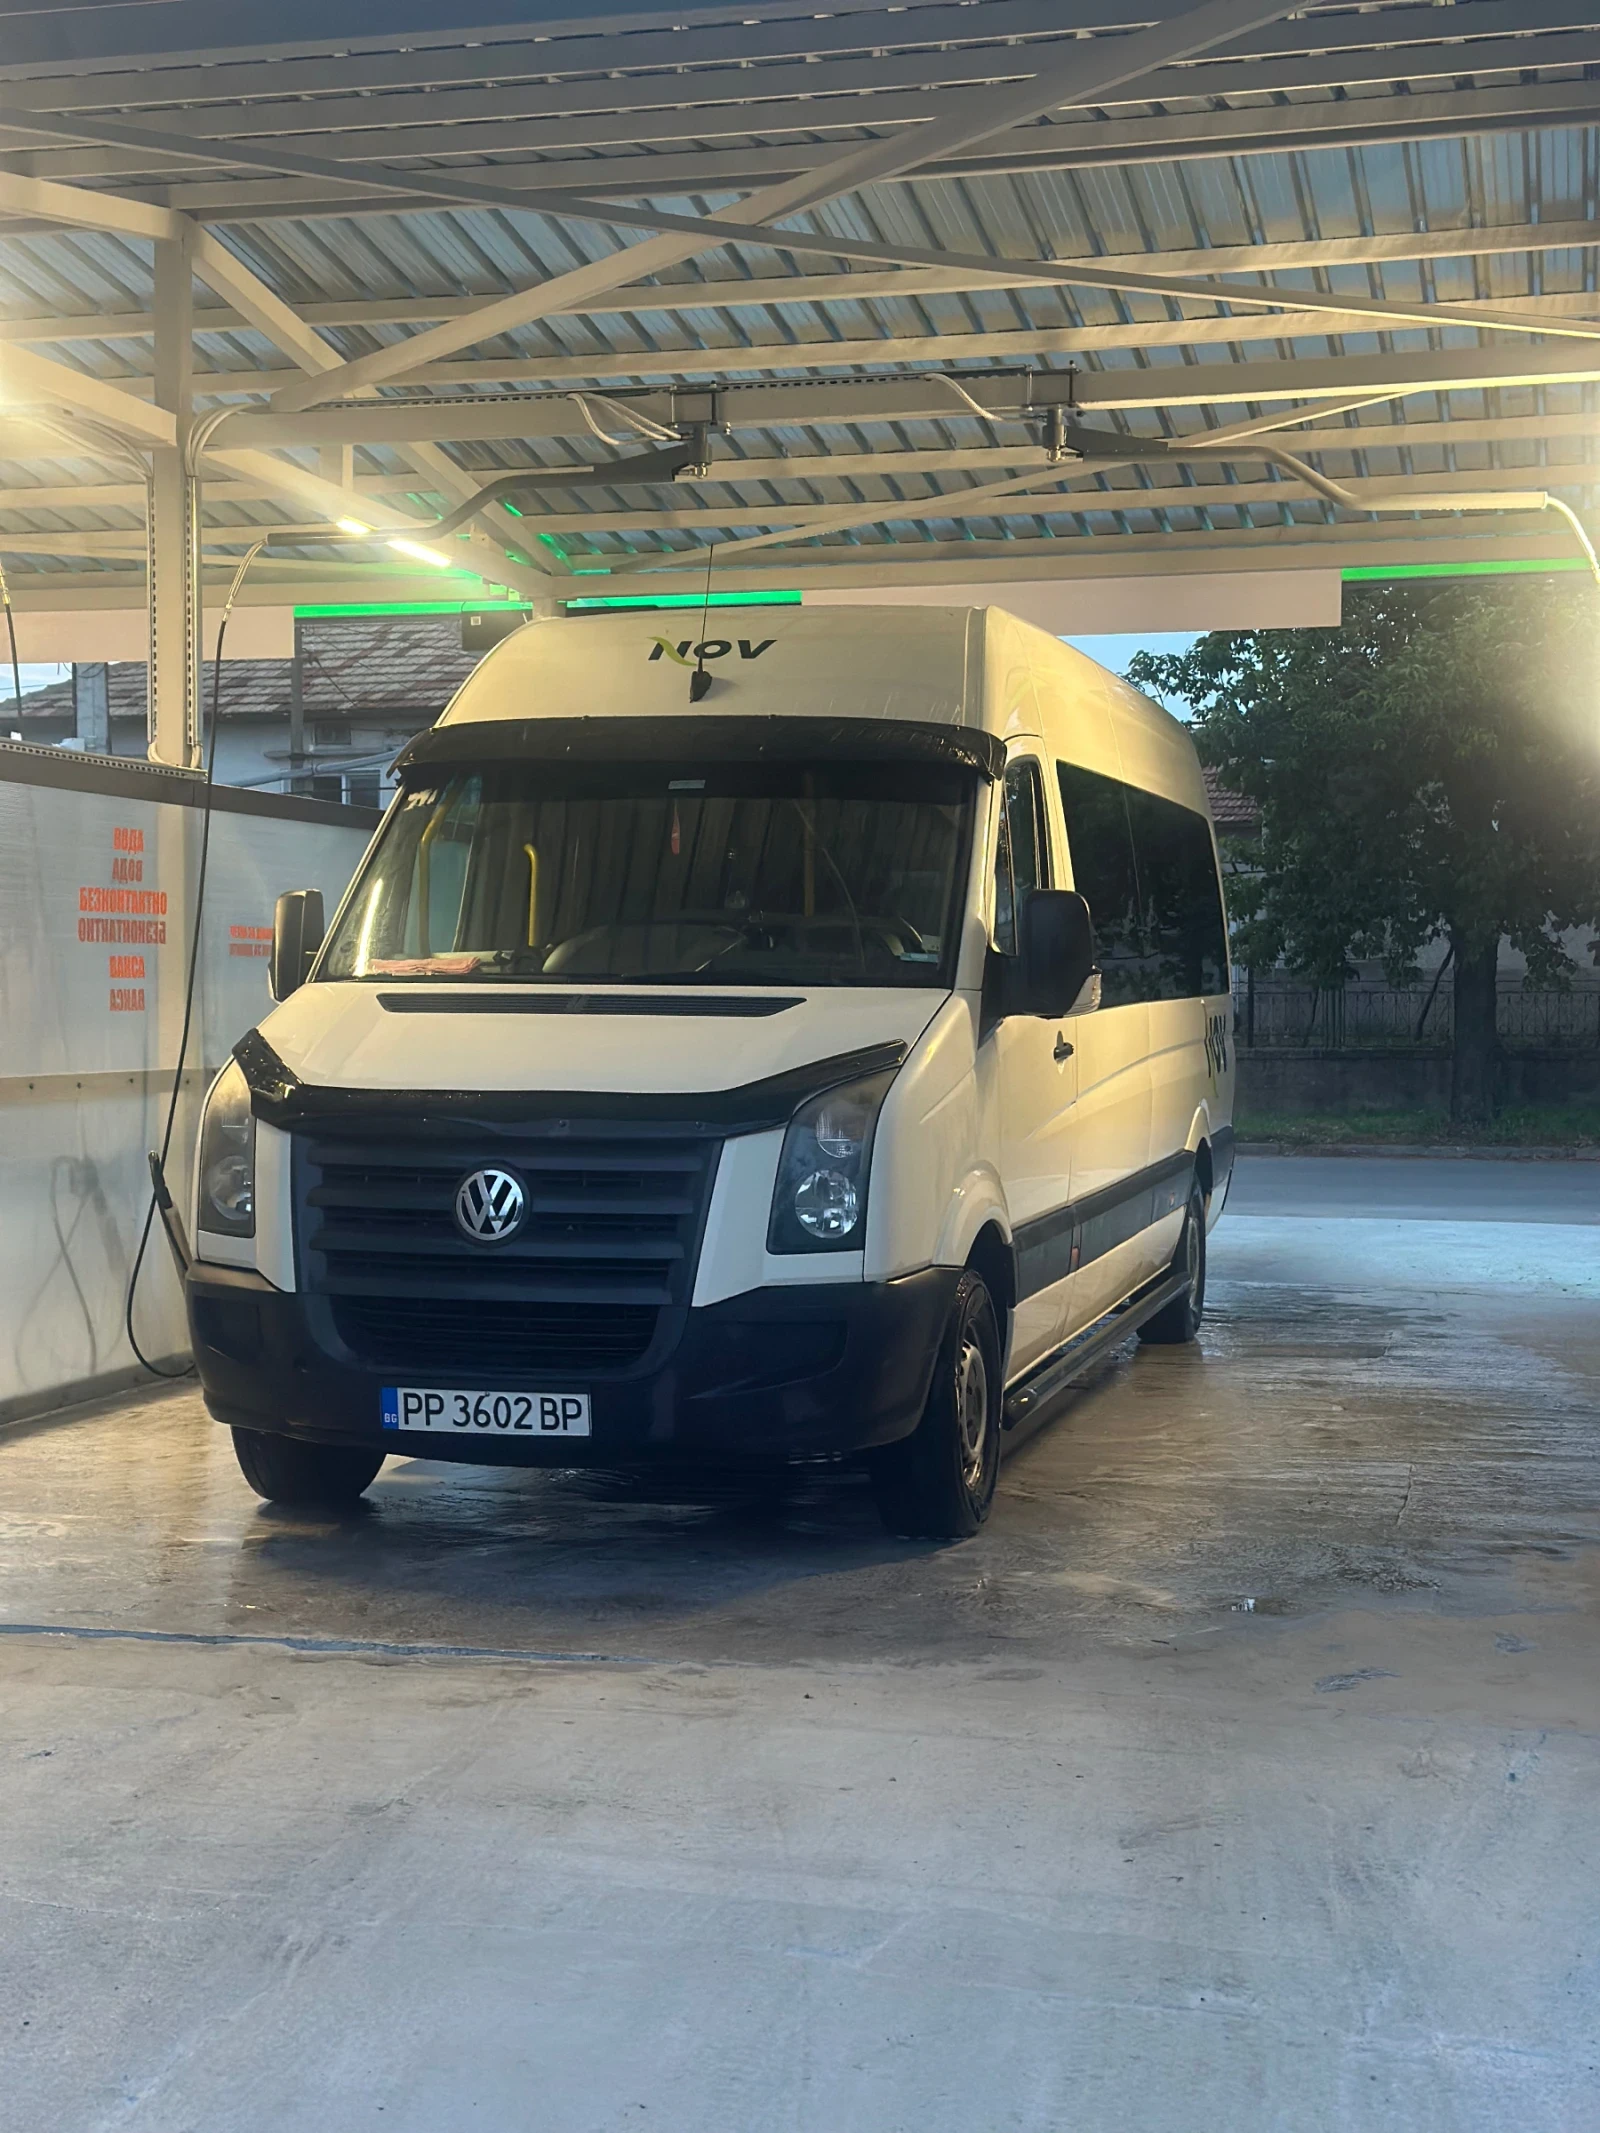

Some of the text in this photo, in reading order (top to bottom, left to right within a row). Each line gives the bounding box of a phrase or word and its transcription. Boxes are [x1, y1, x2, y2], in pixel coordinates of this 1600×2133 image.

[647, 637, 777, 666] NOV
[113, 828, 144, 854] ВОДА
[403, 1392, 582, 1431] PP 3602 BP
